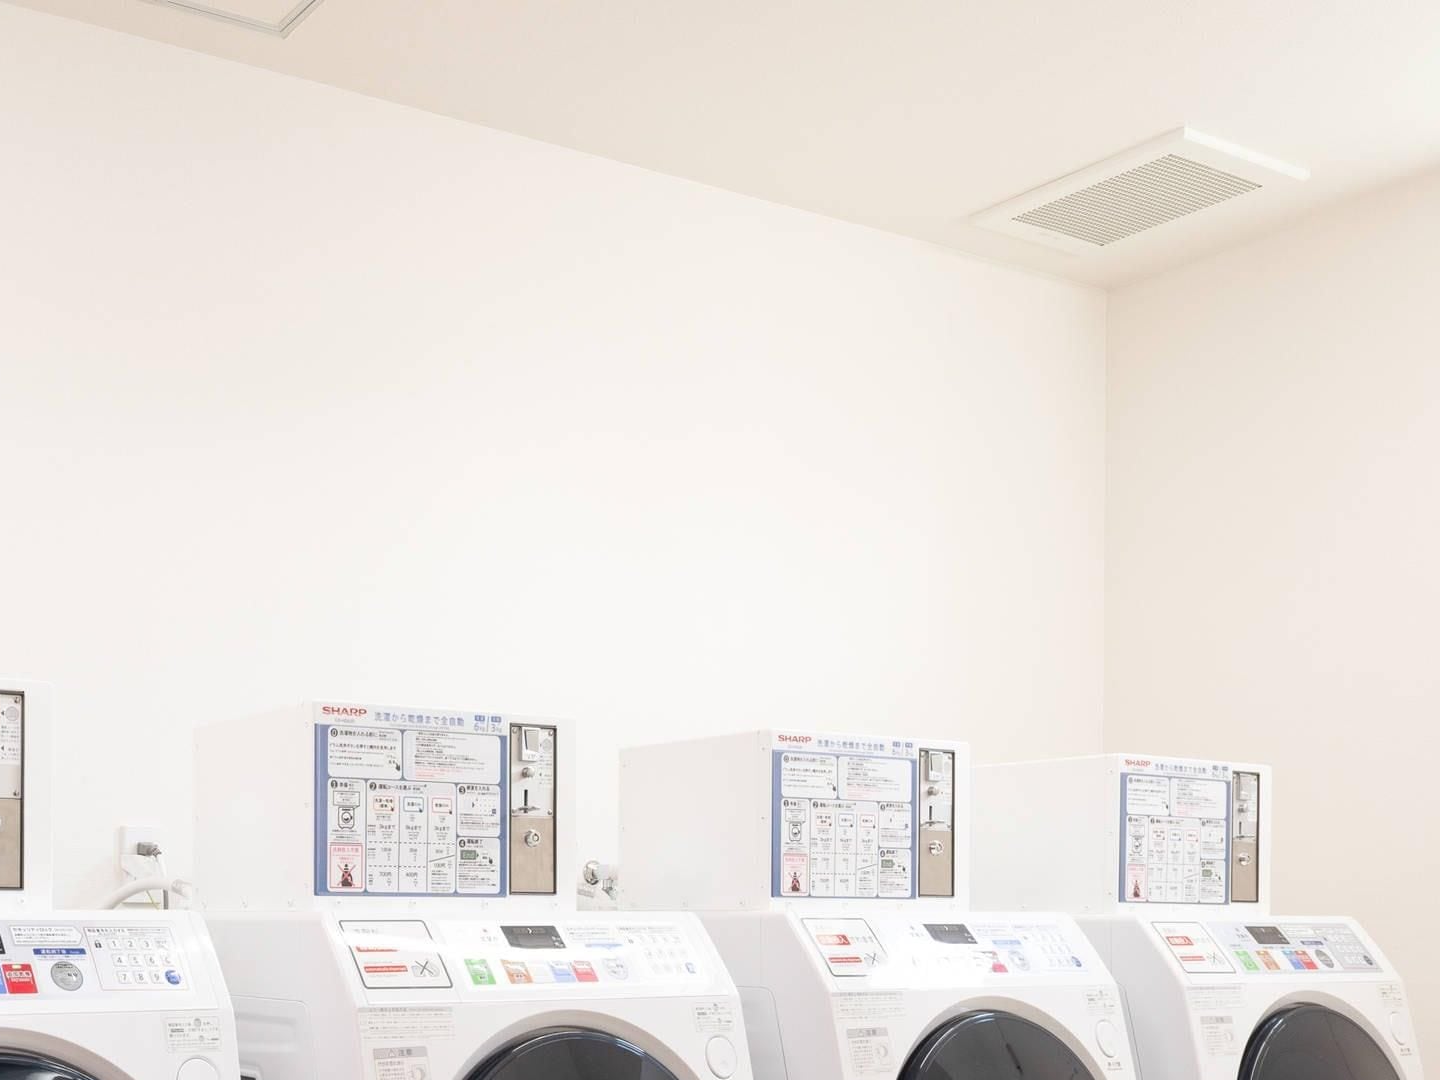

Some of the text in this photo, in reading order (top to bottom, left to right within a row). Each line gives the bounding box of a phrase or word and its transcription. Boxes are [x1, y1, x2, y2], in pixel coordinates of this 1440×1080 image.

[322, 706, 367, 717] SHARP
[374, 712, 465, 727] 洗濯から乾燥まで全自動
[778, 734, 812, 744] SHARP
[1124, 759, 1151, 767] SHARP
